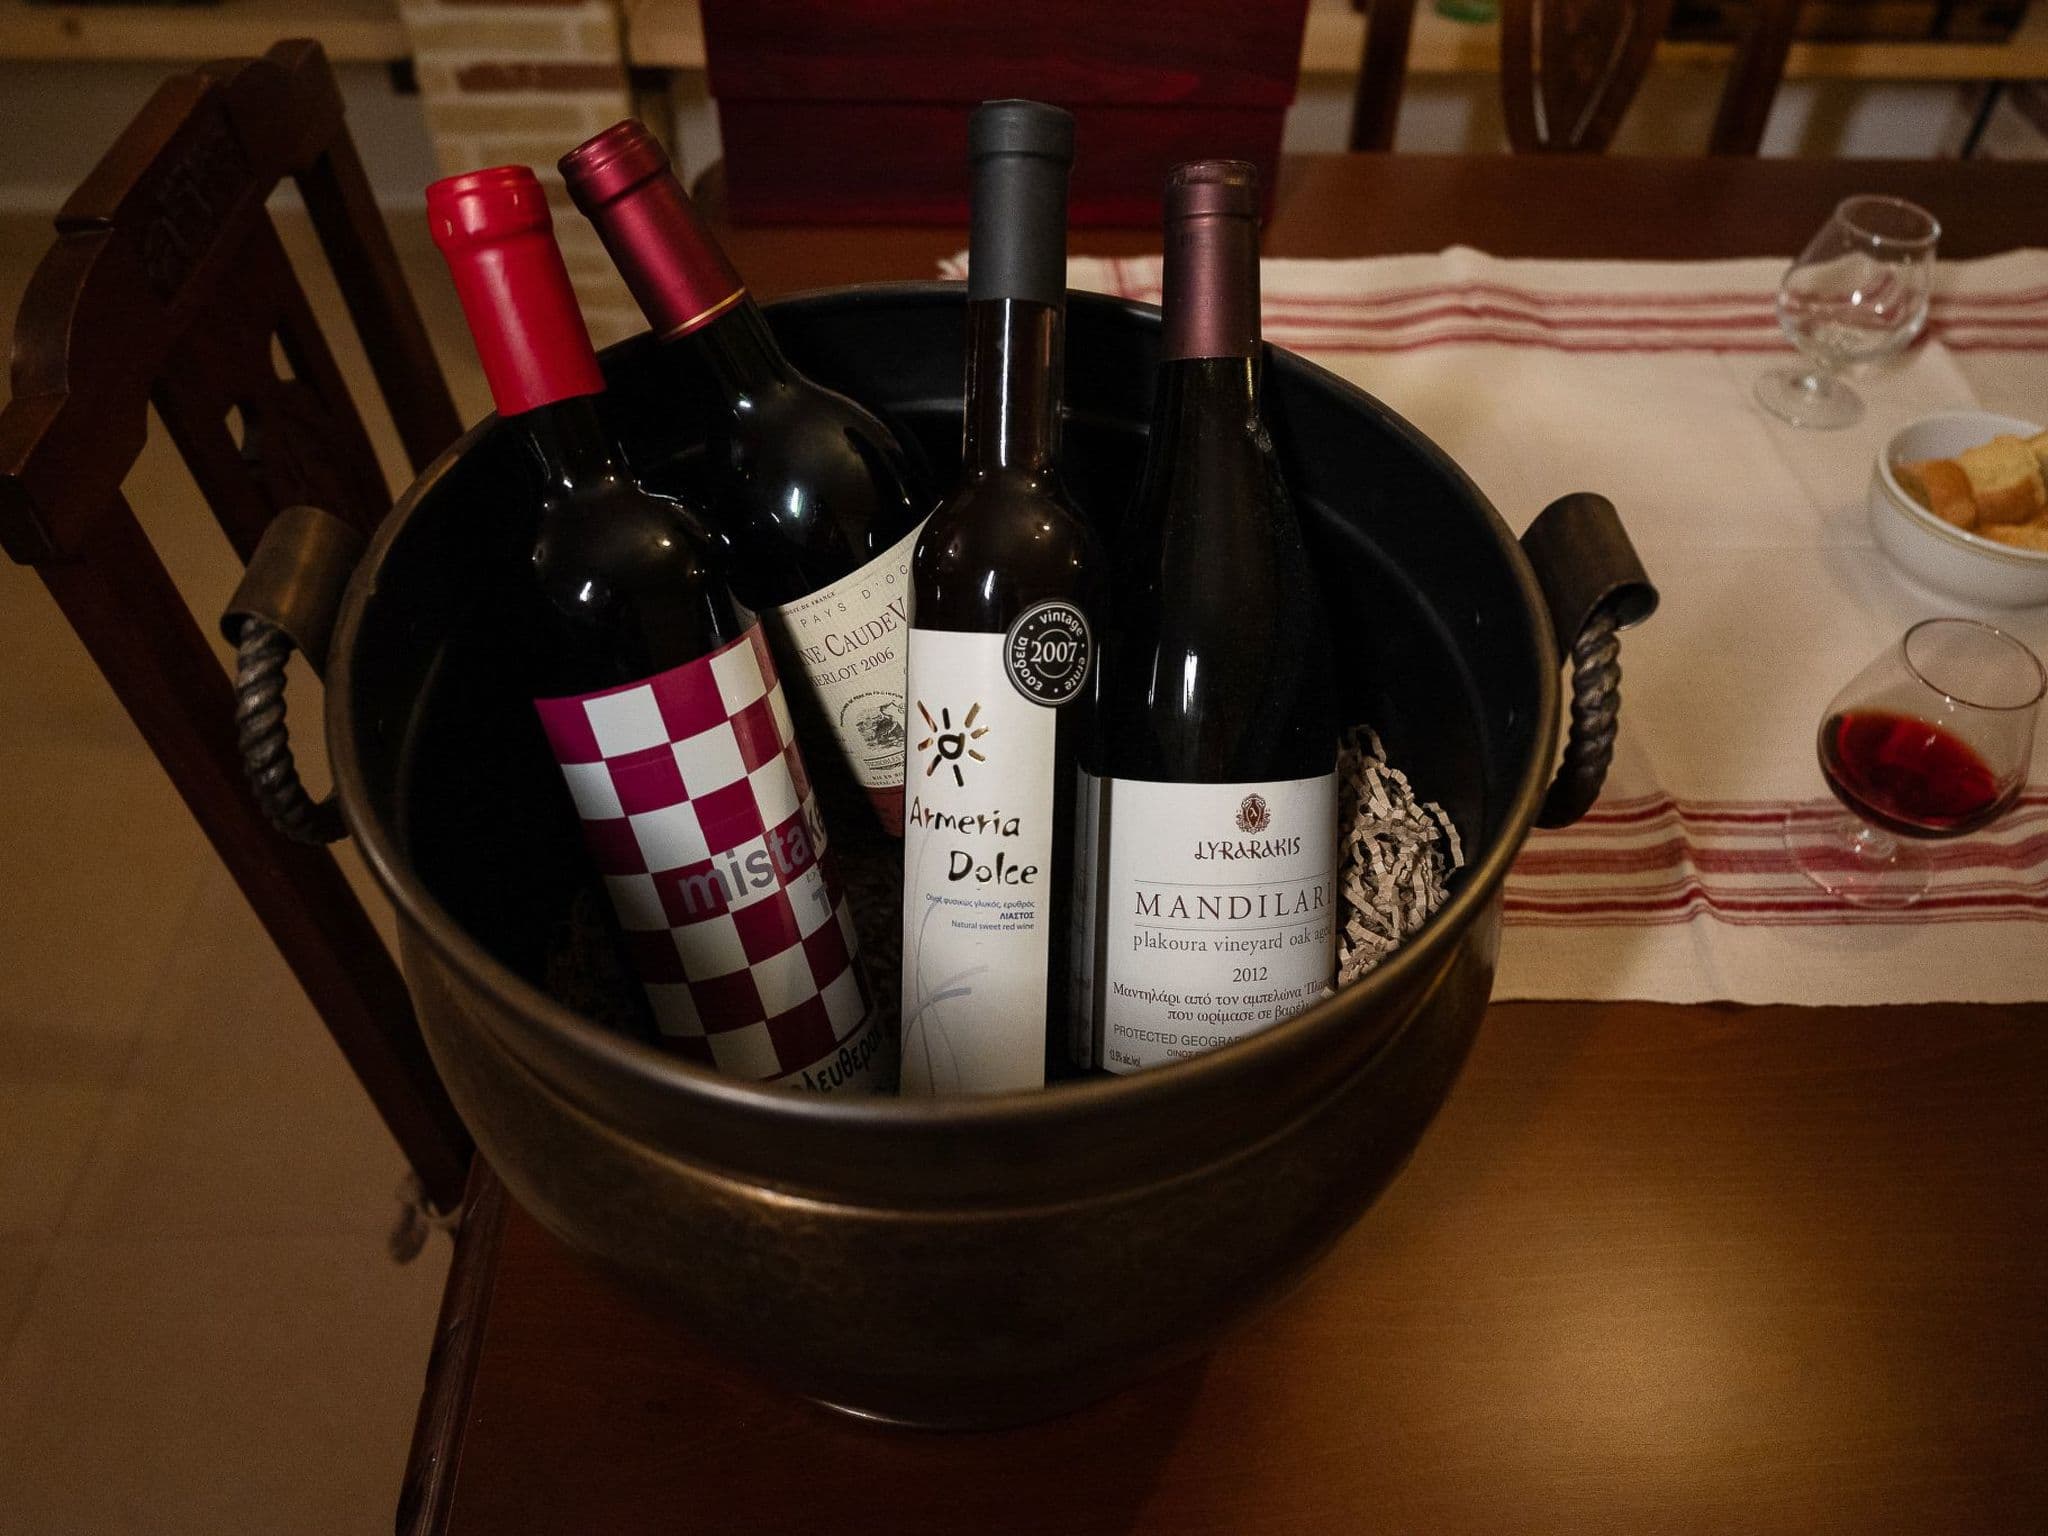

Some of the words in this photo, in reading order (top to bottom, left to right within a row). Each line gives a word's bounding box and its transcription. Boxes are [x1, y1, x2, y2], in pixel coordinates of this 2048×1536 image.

[800, 602, 847, 628] PAYS
[862, 564, 908, 599] D'OC
[797, 645, 827, 666] NE
[824, 597, 908, 657] CAUDEV
[1039, 610, 1083, 636] vintage
[860, 647, 895, 671] 2006
[1013, 636, 1044, 691] εσοδεία
[1030, 640, 1078, 663] 2007
[1064, 656, 1086, 690] ernte
[910, 796, 1020, 837] Armeria
[948, 850, 1038, 885] Dolce
[951, 920, 978, 930] Natural
[979, 923, 1001, 931] sweet
[1002, 922, 1016, 931] red
[1017, 923, 1035, 931] wine
[1133, 931, 1208, 952] plakoura
[1213, 933, 1283, 956] vineyard
[1289, 927, 1312, 946] oak
[1232, 966, 1269, 983] 2012
[1112, 982, 1181, 1004] Μαντηλάρι
[1184, 992, 1212, 1005] από
[1215, 996, 1239, 1005] τον
[1242, 988, 1302, 1007] αμπελώνα
[1167, 1010, 1193, 1021] που
[1197, 1007, 1254, 1024] ωρίμασε
[1257, 1009, 1272, 1020] σε
[1113, 1024, 1177, 1045] PROTECTED
[1180, 1034, 1246, 1047] GEOGRAP
